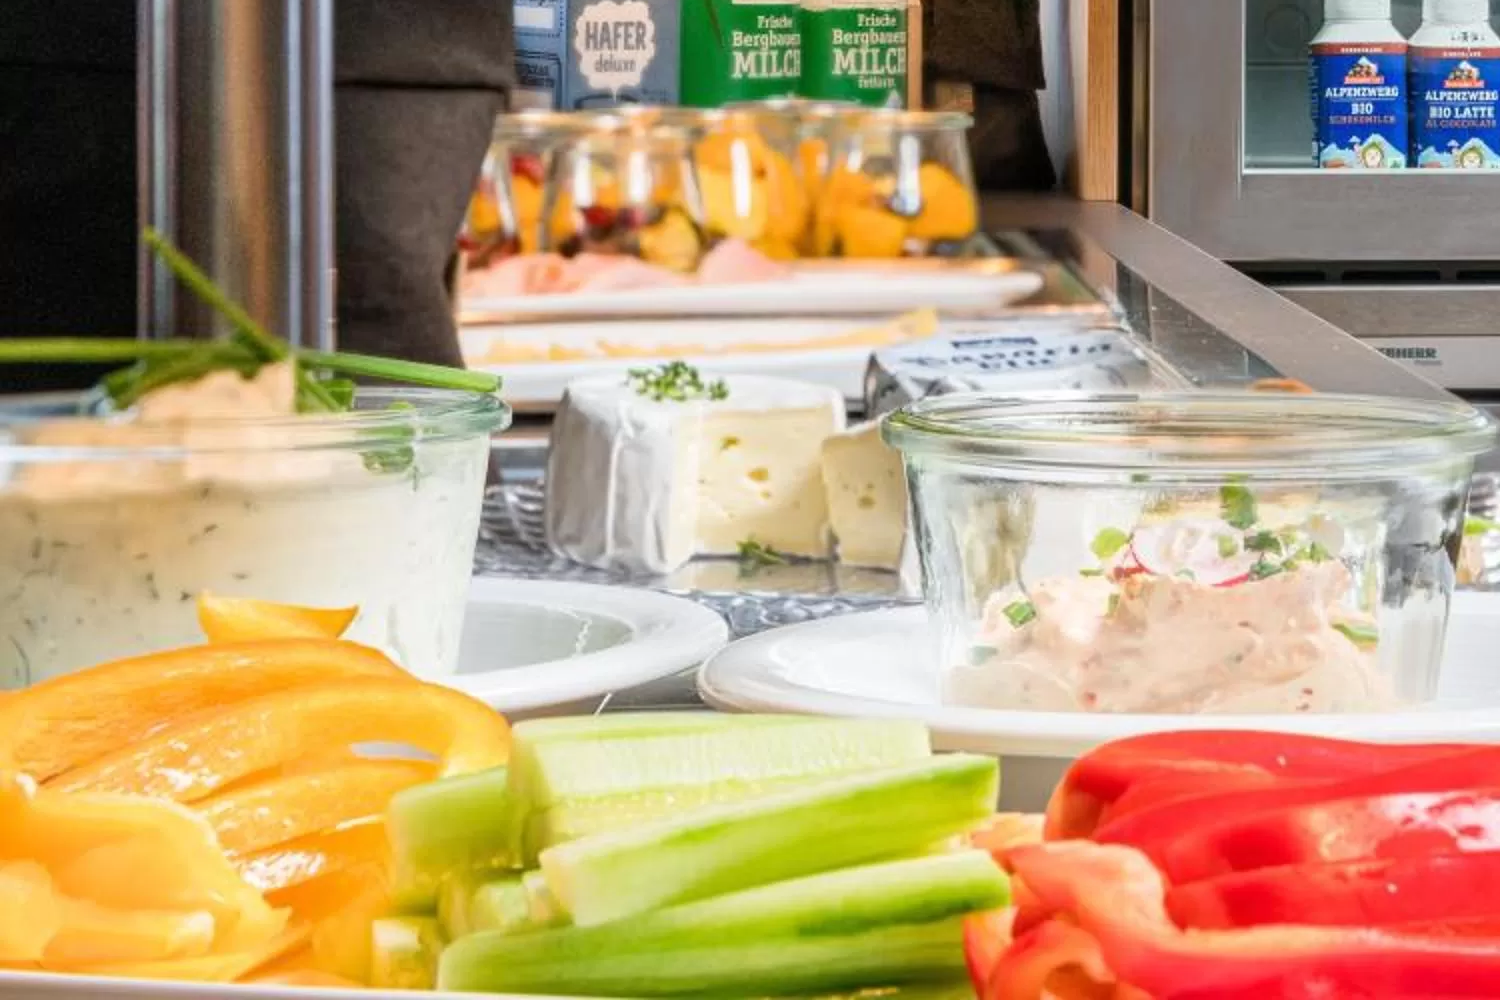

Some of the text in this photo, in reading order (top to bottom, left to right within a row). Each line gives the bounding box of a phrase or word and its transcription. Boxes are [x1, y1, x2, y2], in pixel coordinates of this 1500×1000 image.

[857, 13, 897, 28] Frische
[585, 21, 647, 52] HAFER
[594, 53, 636, 73] deluxe
[1325, 86, 1399, 97] ALPENZWERG
[1425, 90, 1499, 101] ALPENZWERG
[1351, 103, 1374, 115] BIO
[1429, 106, 1495, 119] BIO LATTE
